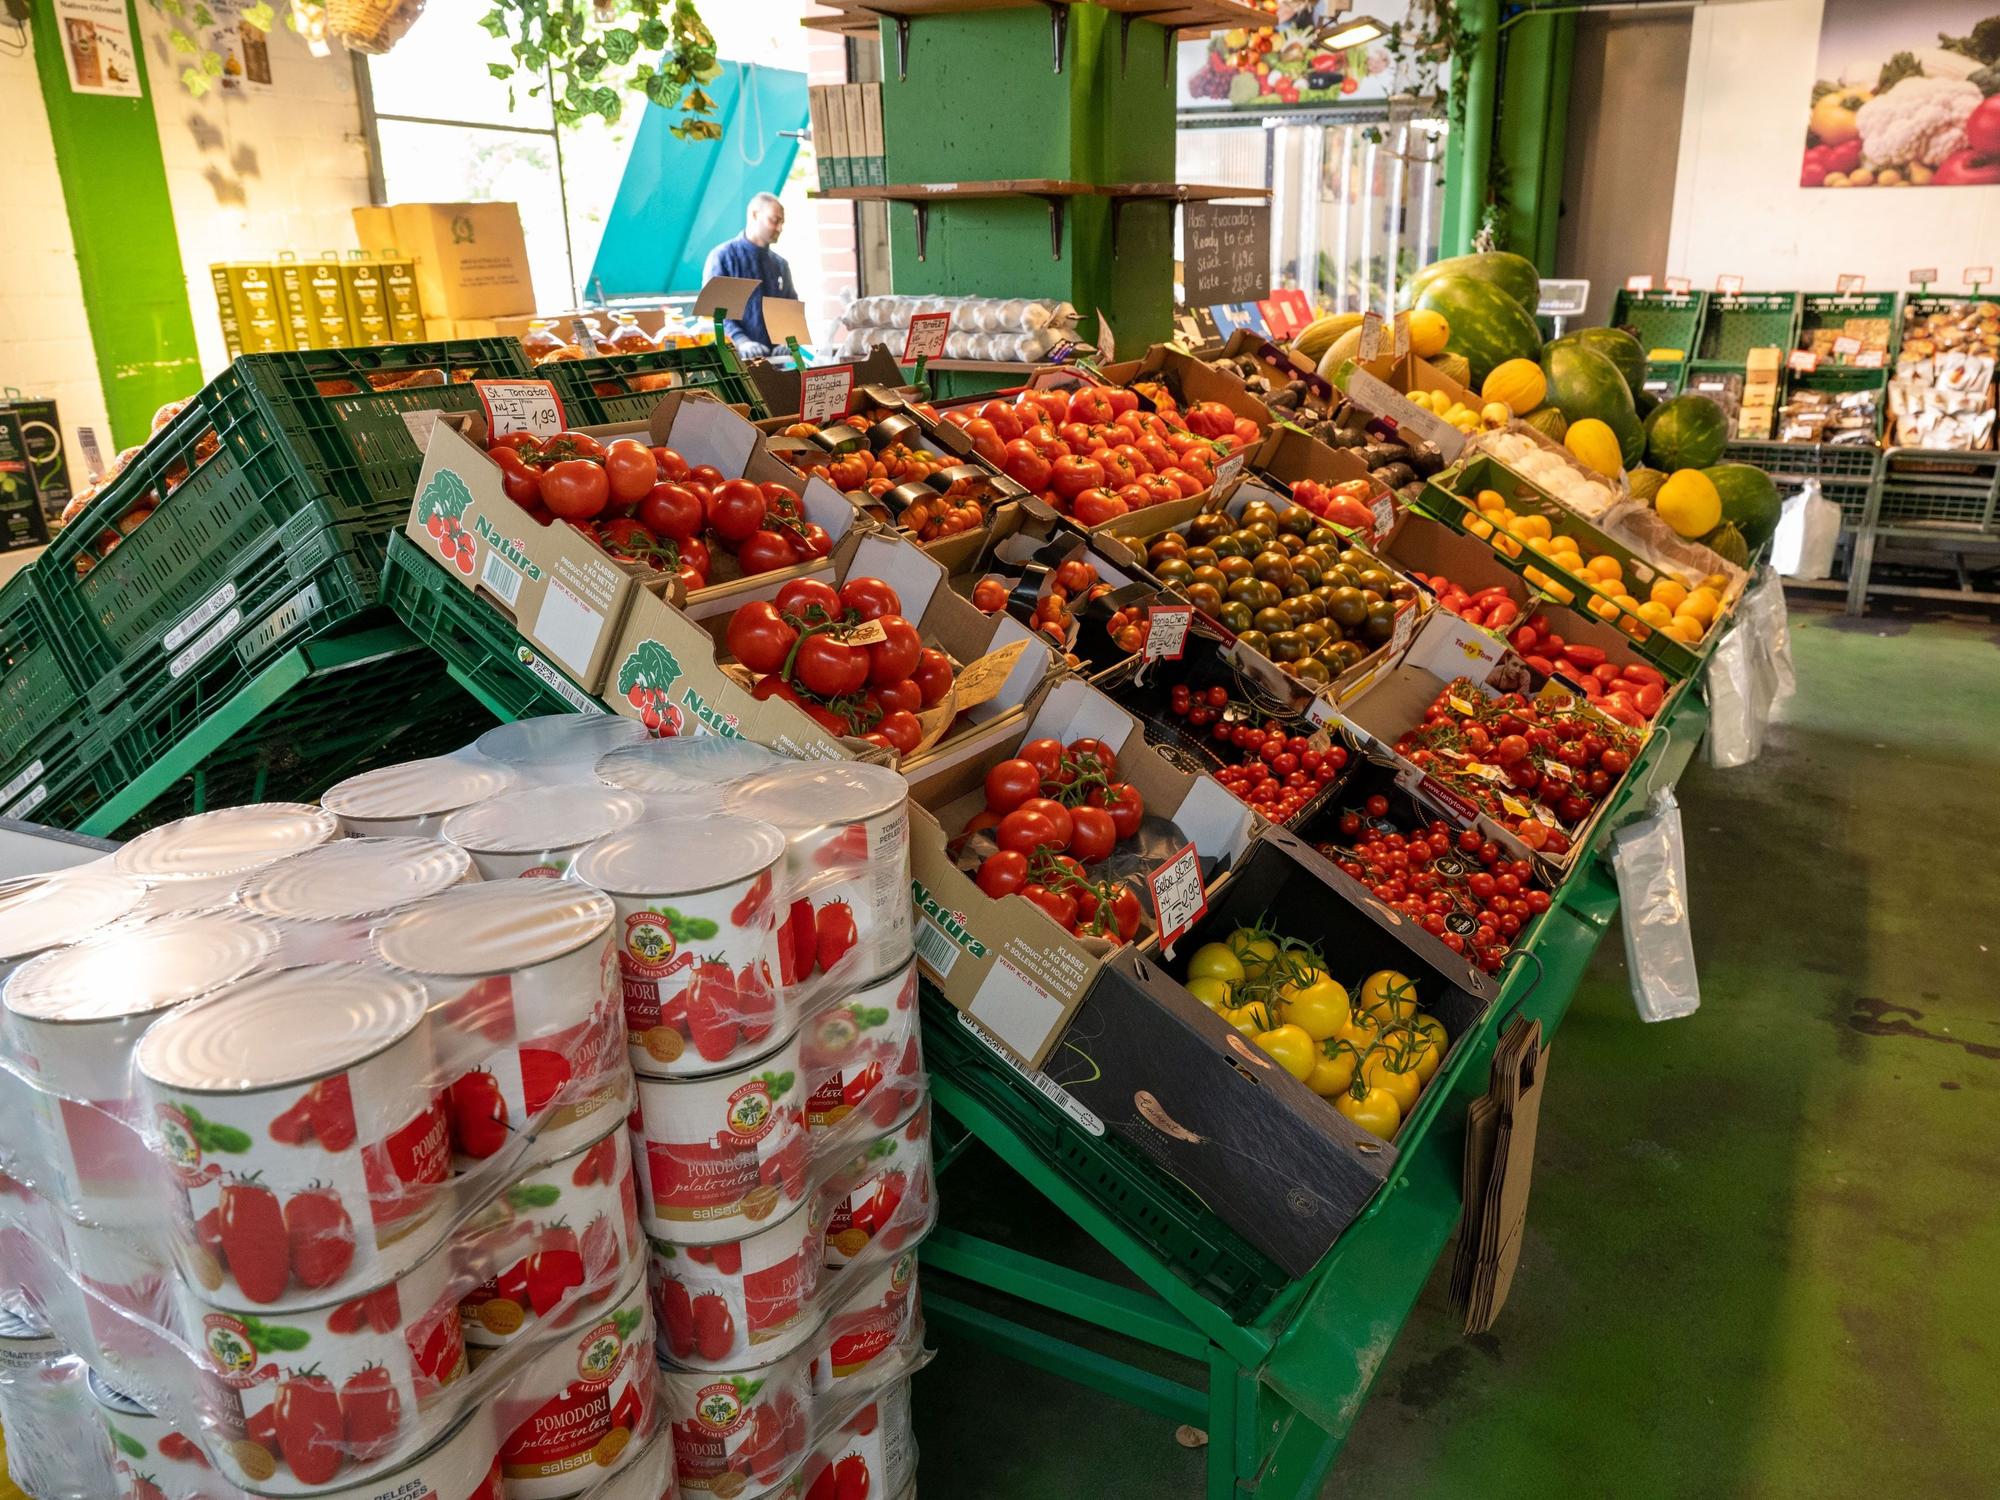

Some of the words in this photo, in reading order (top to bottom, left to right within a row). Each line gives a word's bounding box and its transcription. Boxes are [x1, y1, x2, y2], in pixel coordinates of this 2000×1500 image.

[1192, 229, 1219, 255] Ready
[1224, 230, 1235, 246] to
[487, 387, 504, 398] St.
[504, 387, 551, 398] Tomaten
[532, 408, 557, 430] 1,99
[475, 515, 542, 582] Natura
[561, 556, 583, 577] PRODUCT
[590, 580, 612, 602] HOLLAND
[593, 560, 616, 581] KLASSE
[597, 575, 615, 593] NETTO
[1455, 638, 1476, 654] Tasty
[1477, 649, 1493, 662] Tom
[1423, 780, 1475, 818] www.tastytom.nl
[1181, 877, 1201, 911] 2,99
[628, 912, 667, 925] SELEZIONI
[912, 880, 986, 959] Natura
[629, 960, 683, 979] ALIMENTARI
[1014, 937, 1043, 962] PRODUCT
[1042, 959, 1050, 968] OF
[1050, 966, 1078, 991] HOLLAND
[1043, 947, 1049, 955] 5
[1049, 952, 1060, 964] KG
[1060, 960, 1083, 982] NETTO
[1057, 945, 1085, 971] KLASSE
[1010, 947, 1043, 976] SOLLEVELD
[1043, 973, 1072, 1000] MAASDIJK
[732, 1083, 766, 1100] SELEZIONI
[693, 1202, 742, 1219] salsati
[701, 1384, 735, 1396] SELEZIONI
[535, 1395, 607, 1433] POMODORI
[513, 1430, 569, 1456] pelati
[571, 1414, 611, 1438] interi
[540, 1449, 593, 1475] salsati
